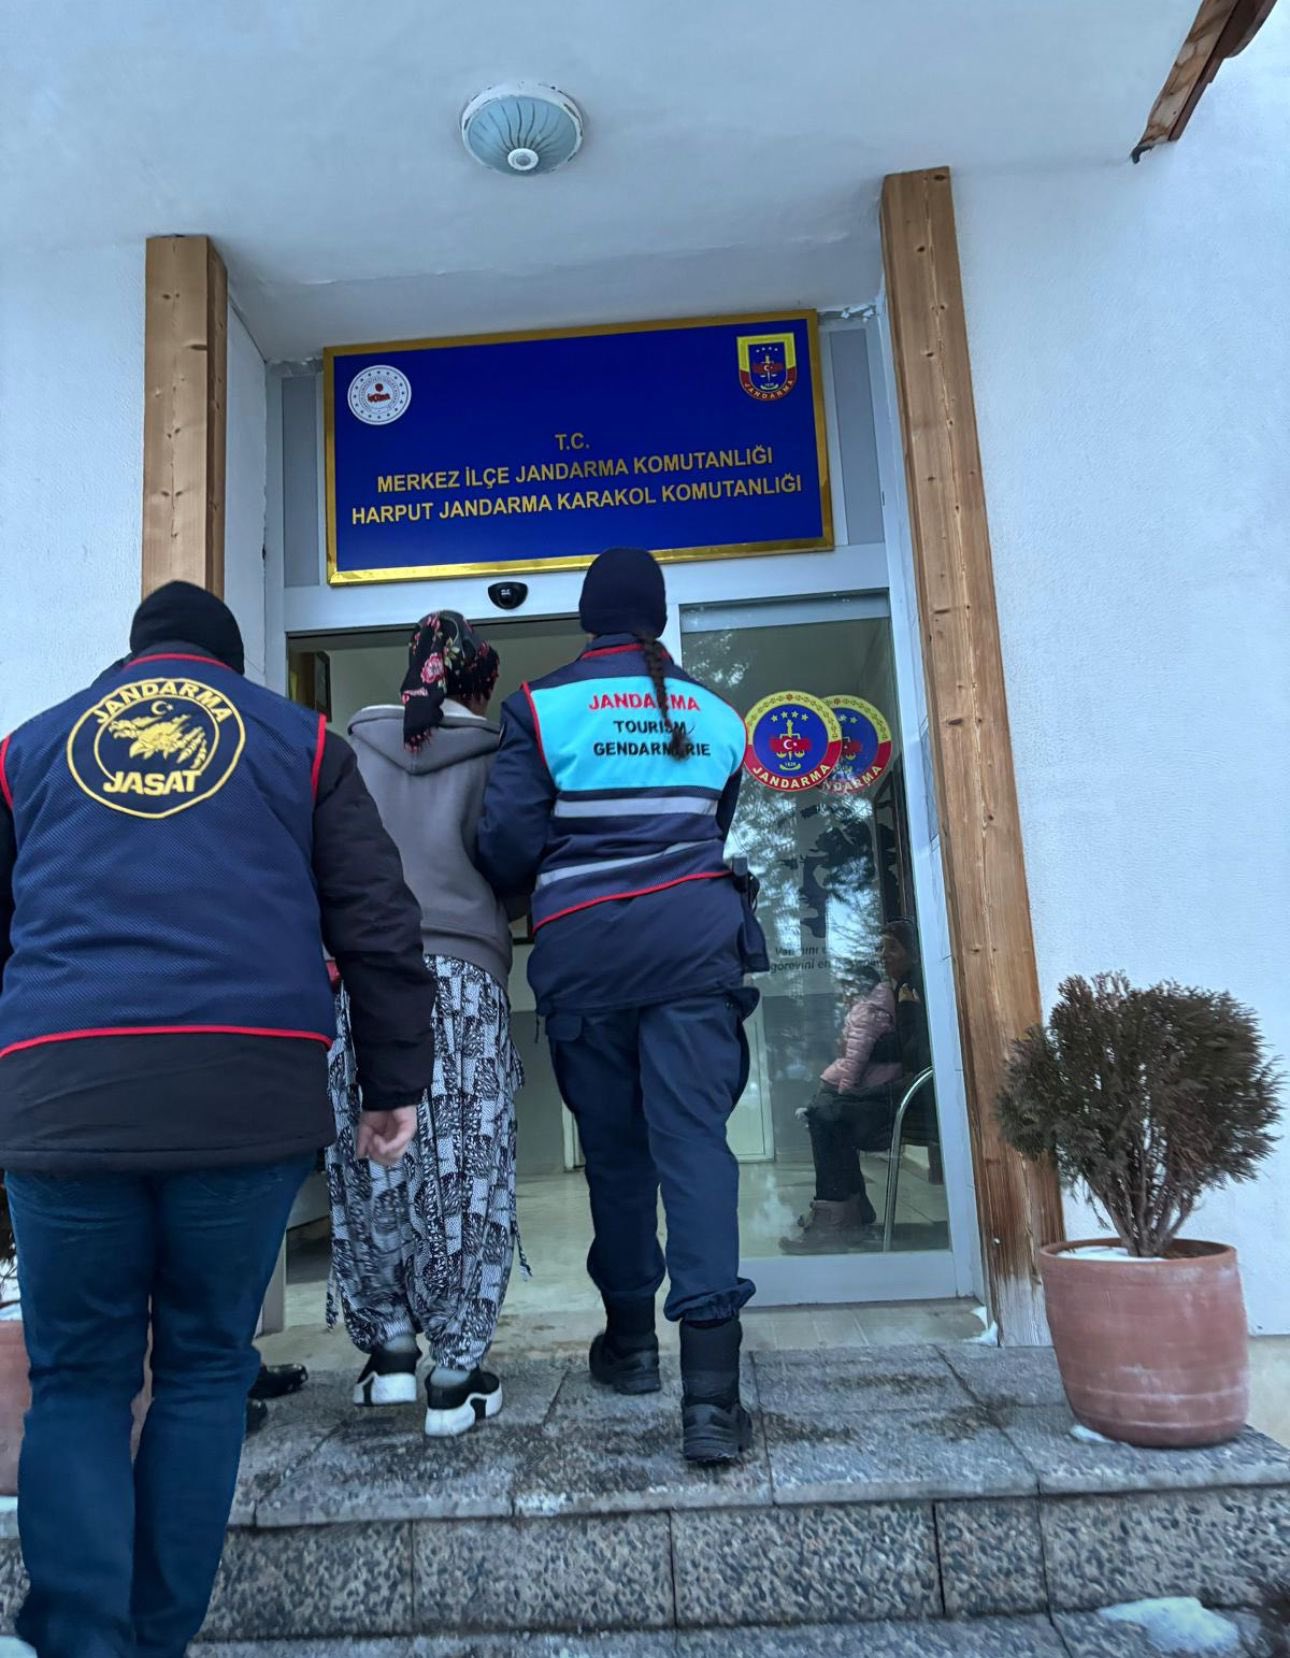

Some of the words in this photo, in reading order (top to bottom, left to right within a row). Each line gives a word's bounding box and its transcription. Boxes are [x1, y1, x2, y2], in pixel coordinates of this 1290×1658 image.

[744, 380, 793, 399] JANDARMA
[555, 432, 589, 450] T.C.
[377, 470, 460, 493] MERKEZ
[465, 466, 510, 489] İLÇE
[515, 459, 629, 483] JANDARMA
[633, 444, 773, 474] KOMUTANLIĞI
[352, 502, 434, 525] HARPUT
[439, 494, 552, 519] JANDARMA
[557, 487, 656, 510] KARAKOL
[662, 472, 802, 502] KOMUTANLIĞI
[92, 681, 233, 724] JANDARMA
[589, 692, 701, 711] JANDAMA
[593, 741, 711, 757] GENDARMRIE
[102, 769, 201, 796] JASAT
[752, 763, 832, 789] JANDARMA
[822, 765, 883, 791] NDARMA
